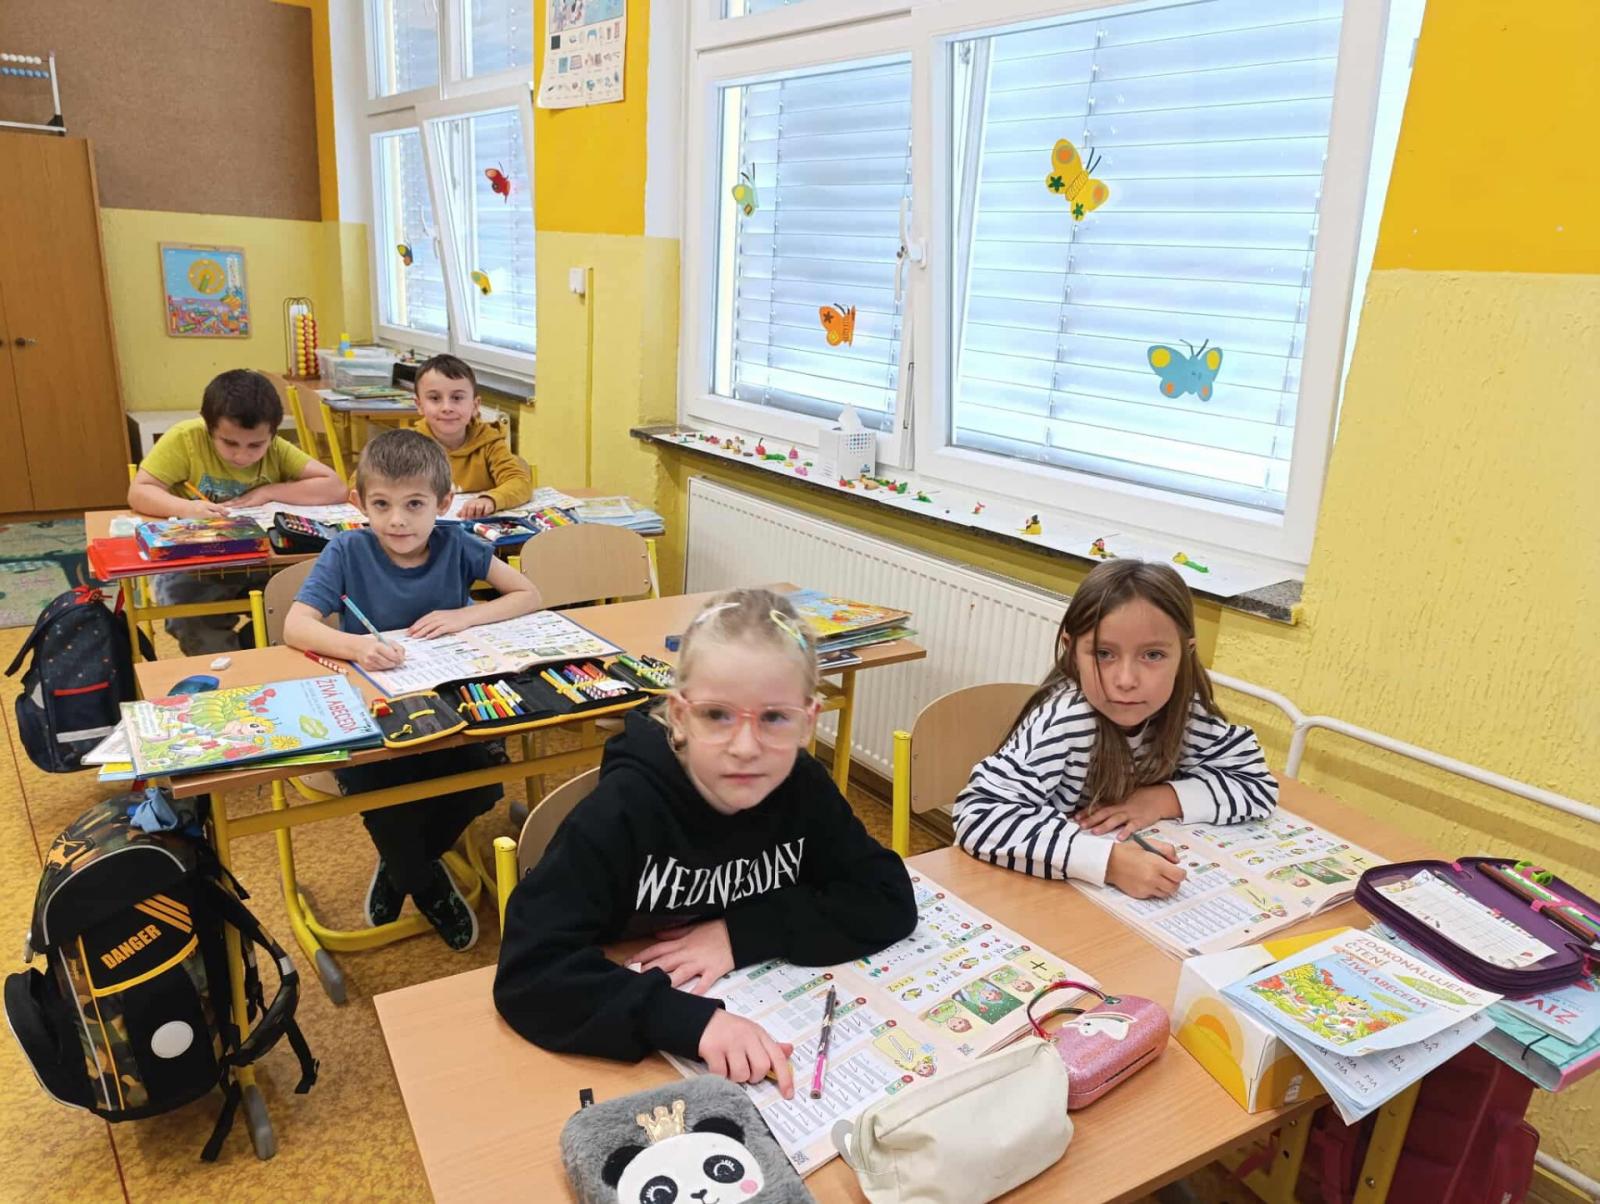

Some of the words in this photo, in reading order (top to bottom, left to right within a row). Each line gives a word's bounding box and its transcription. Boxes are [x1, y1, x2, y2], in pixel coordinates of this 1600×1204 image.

[316, 679, 343, 699] ŽIVÁ
[635, 836, 806, 912] WEDNESDAY
[100, 924, 162, 970] DANGER
[1344, 941, 1391, 967] ČTENÍ
[1356, 937, 1481, 1000] ZDOKONALUJEME
[1369, 975, 1429, 1009] ABECEDA
[1525, 998, 1580, 1024] ŽIV
